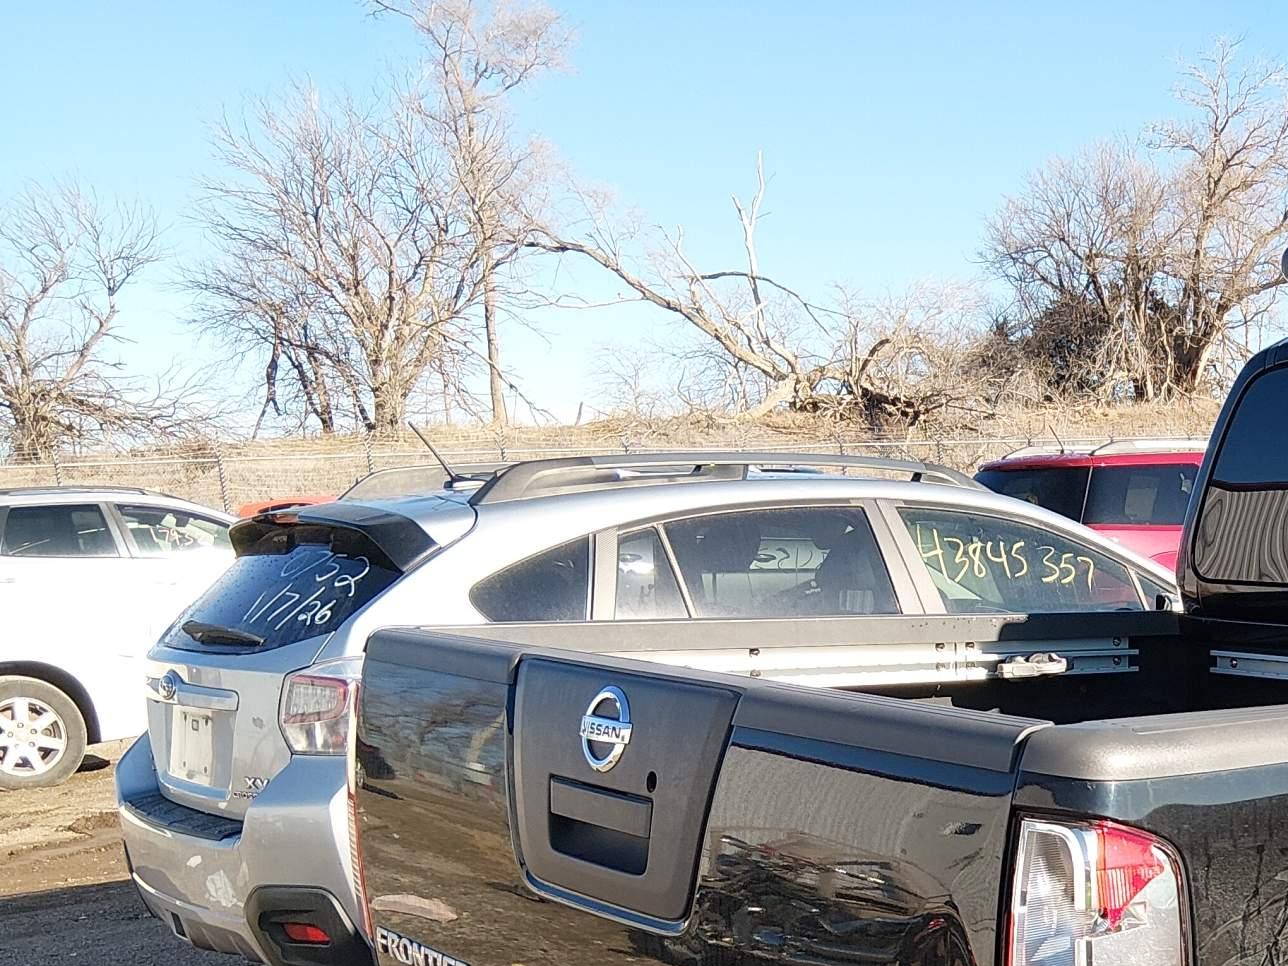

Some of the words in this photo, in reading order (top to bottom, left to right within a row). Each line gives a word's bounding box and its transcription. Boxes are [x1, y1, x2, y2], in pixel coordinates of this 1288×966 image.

[916, 524, 1028, 584] 43845
[1036, 546, 1095, 593] 357
[580, 719, 622, 740] NISSAN
[245, 776, 270, 793] XV
